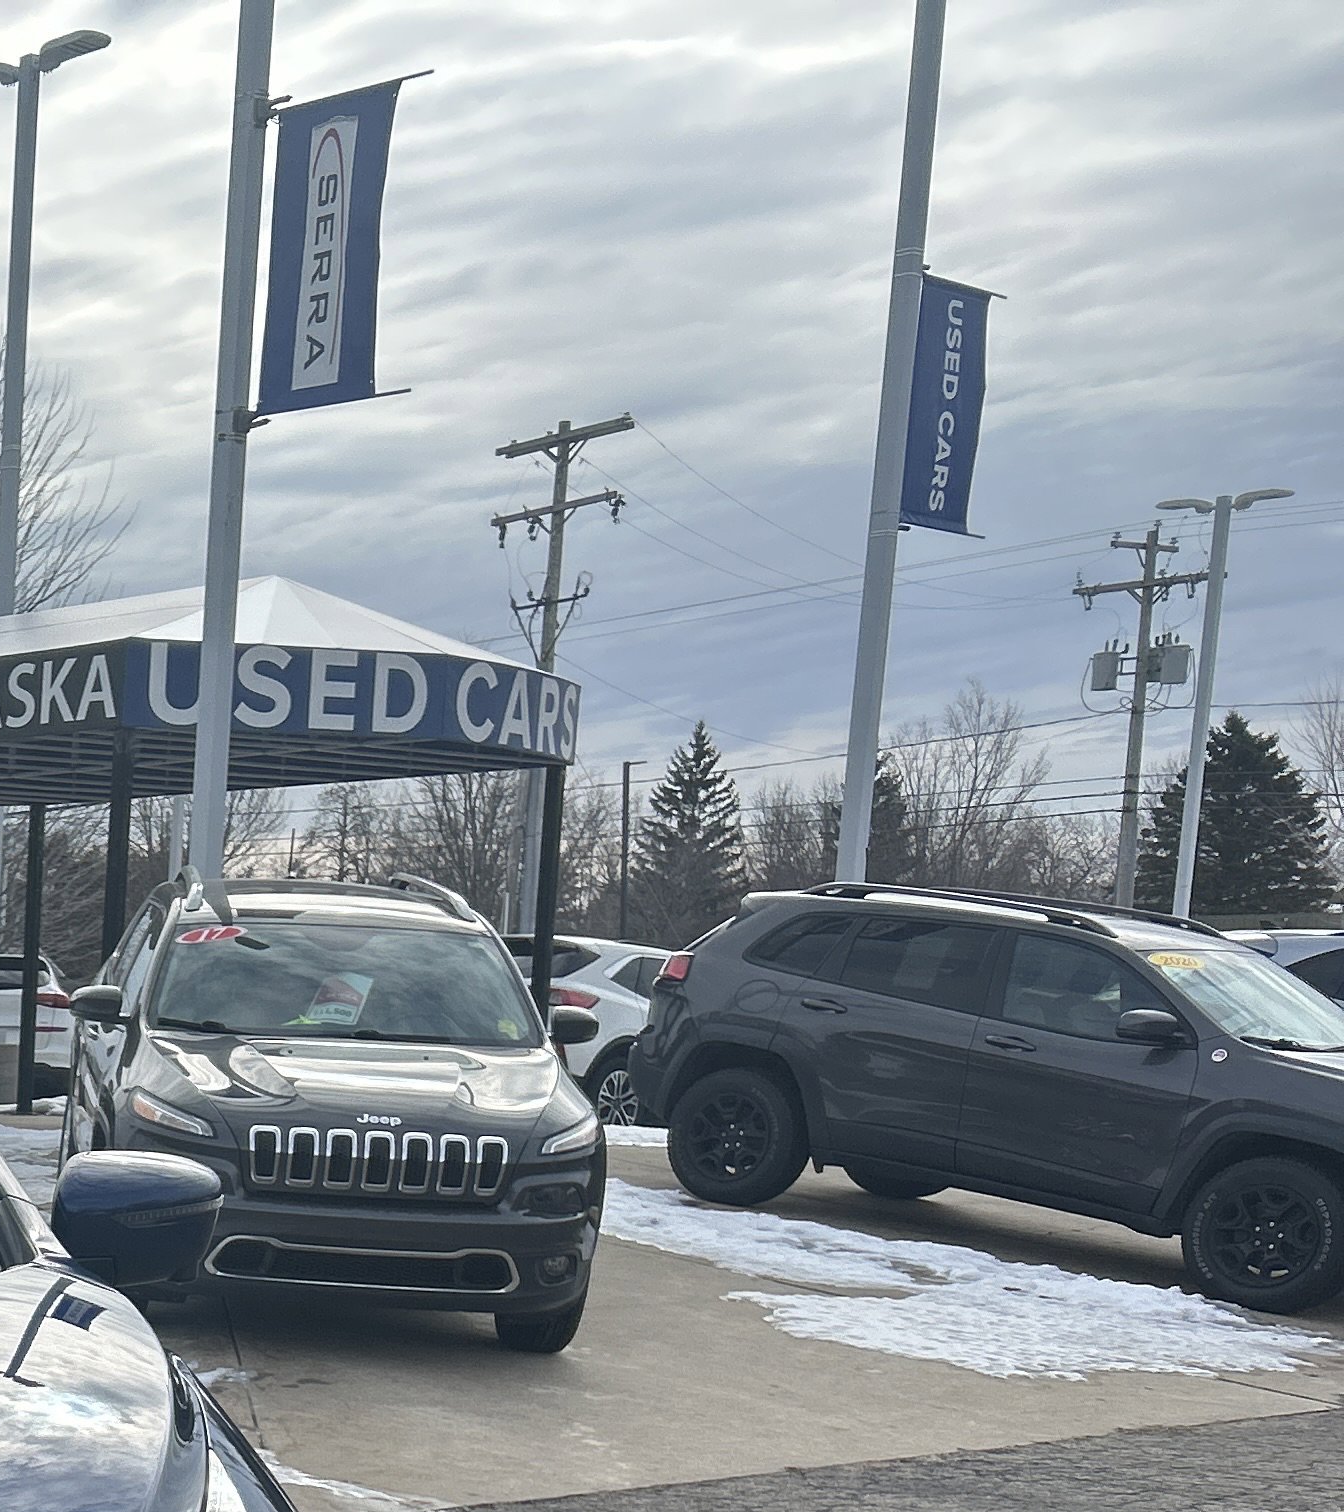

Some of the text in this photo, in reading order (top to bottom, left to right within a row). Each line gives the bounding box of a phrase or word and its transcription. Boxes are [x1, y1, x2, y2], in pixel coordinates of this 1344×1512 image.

[304, 173, 338, 371] SERRA
[928, 299, 964, 512] USED CARS
[147, 641, 578, 762] USED CARS
[356, 1113, 403, 1127] Jeep
